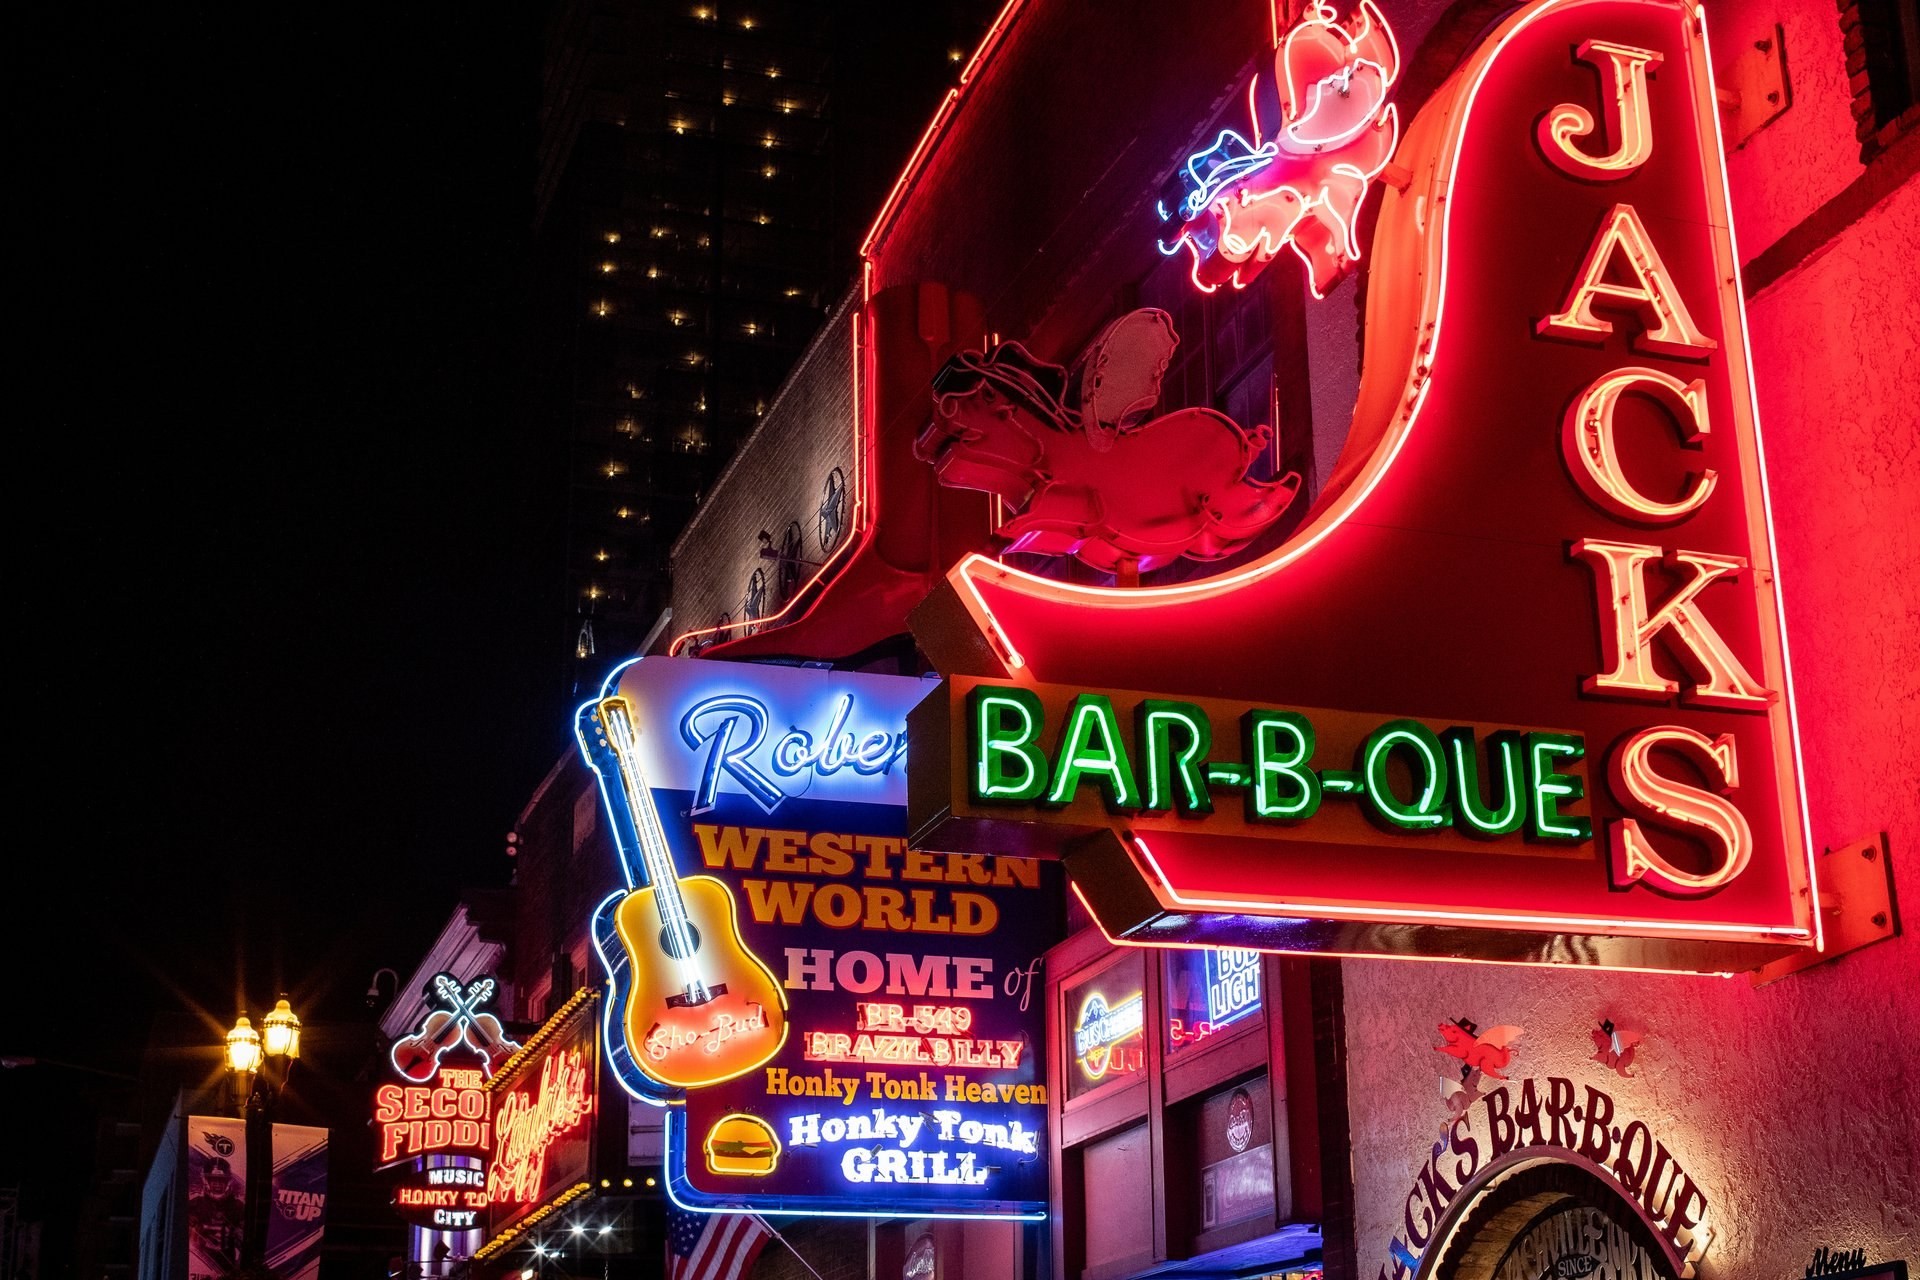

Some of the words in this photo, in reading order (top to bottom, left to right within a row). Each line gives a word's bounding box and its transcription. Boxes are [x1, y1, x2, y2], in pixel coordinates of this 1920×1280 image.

[1538, 39, 1777, 892] JACKS
[968, 684, 1592, 845] BAR-B-QUE
[692, 823, 1041, 889] WESTERN
[742, 878, 1000, 936] WORLD
[784, 947, 994, 999] HOME
[1004, 957, 1043, 1011] of
[1211, 962, 1261, 1020] LIGH
[648, 1004, 764, 1060] Sho-Bud
[857, 1002, 971, 1036] BR-549
[440, 1069, 483, 1089] THE
[766, 1068, 860, 1105] Honky
[866, 1072, 937, 1100] Tonk
[945, 1075, 1048, 1104] Heaven
[377, 1084, 490, 1123] SECO
[789, 1108, 924, 1147] Honky
[934, 1110, 1036, 1153] Tonk
[429, 1169, 485, 1187] MUSIC
[841, 1147, 988, 1185] GRILL
[278, 1189, 325, 1207] TITAN
[295, 1206, 321, 1221] UP
[401, 1188, 459, 1206] HONKY
[1376, 1111, 1480, 1280] ACK'S
[433, 1208, 477, 1226] CITY
[1557, 1256, 1593, 1276] SINCE
[1806, 1246, 1866, 1278] Menu
